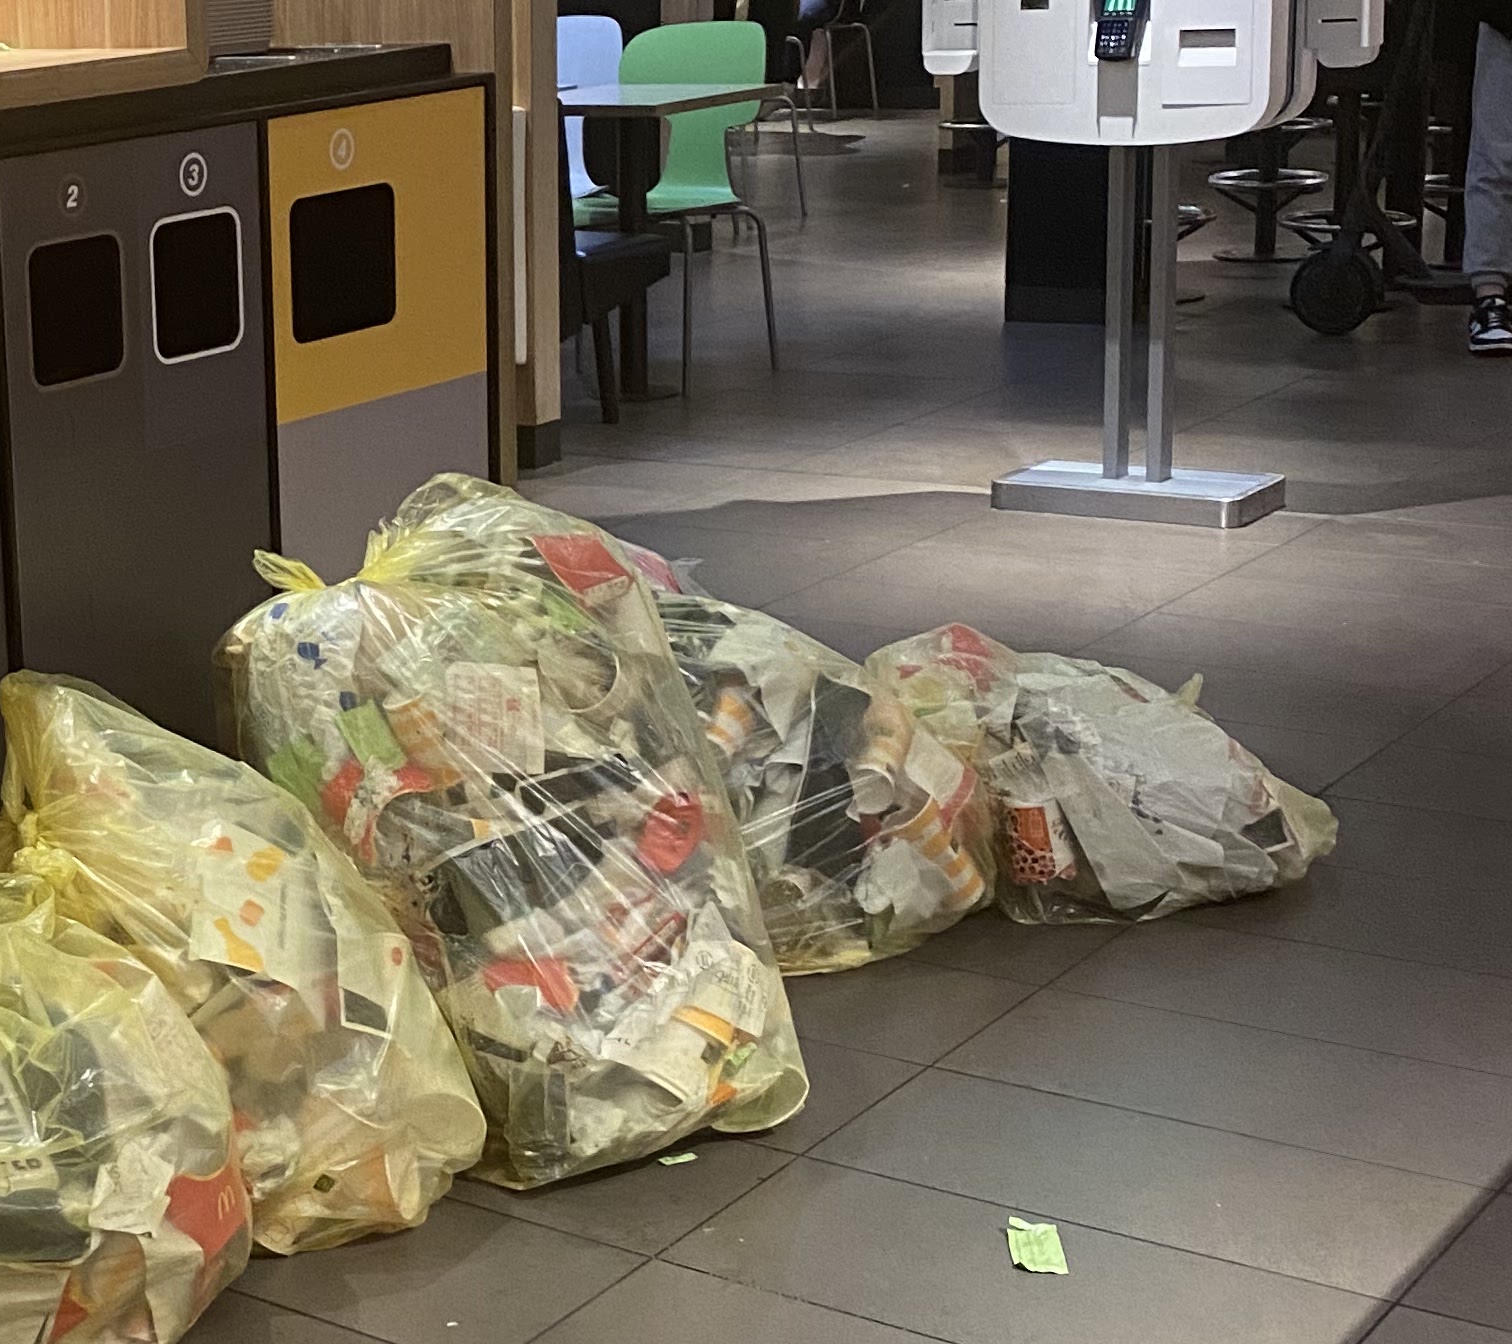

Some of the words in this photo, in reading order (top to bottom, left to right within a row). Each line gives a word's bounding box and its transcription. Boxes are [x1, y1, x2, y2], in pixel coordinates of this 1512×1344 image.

[338, 138, 347, 159] 4
[187, 163, 199, 185] 3
[67, 185, 78, 208] 2
